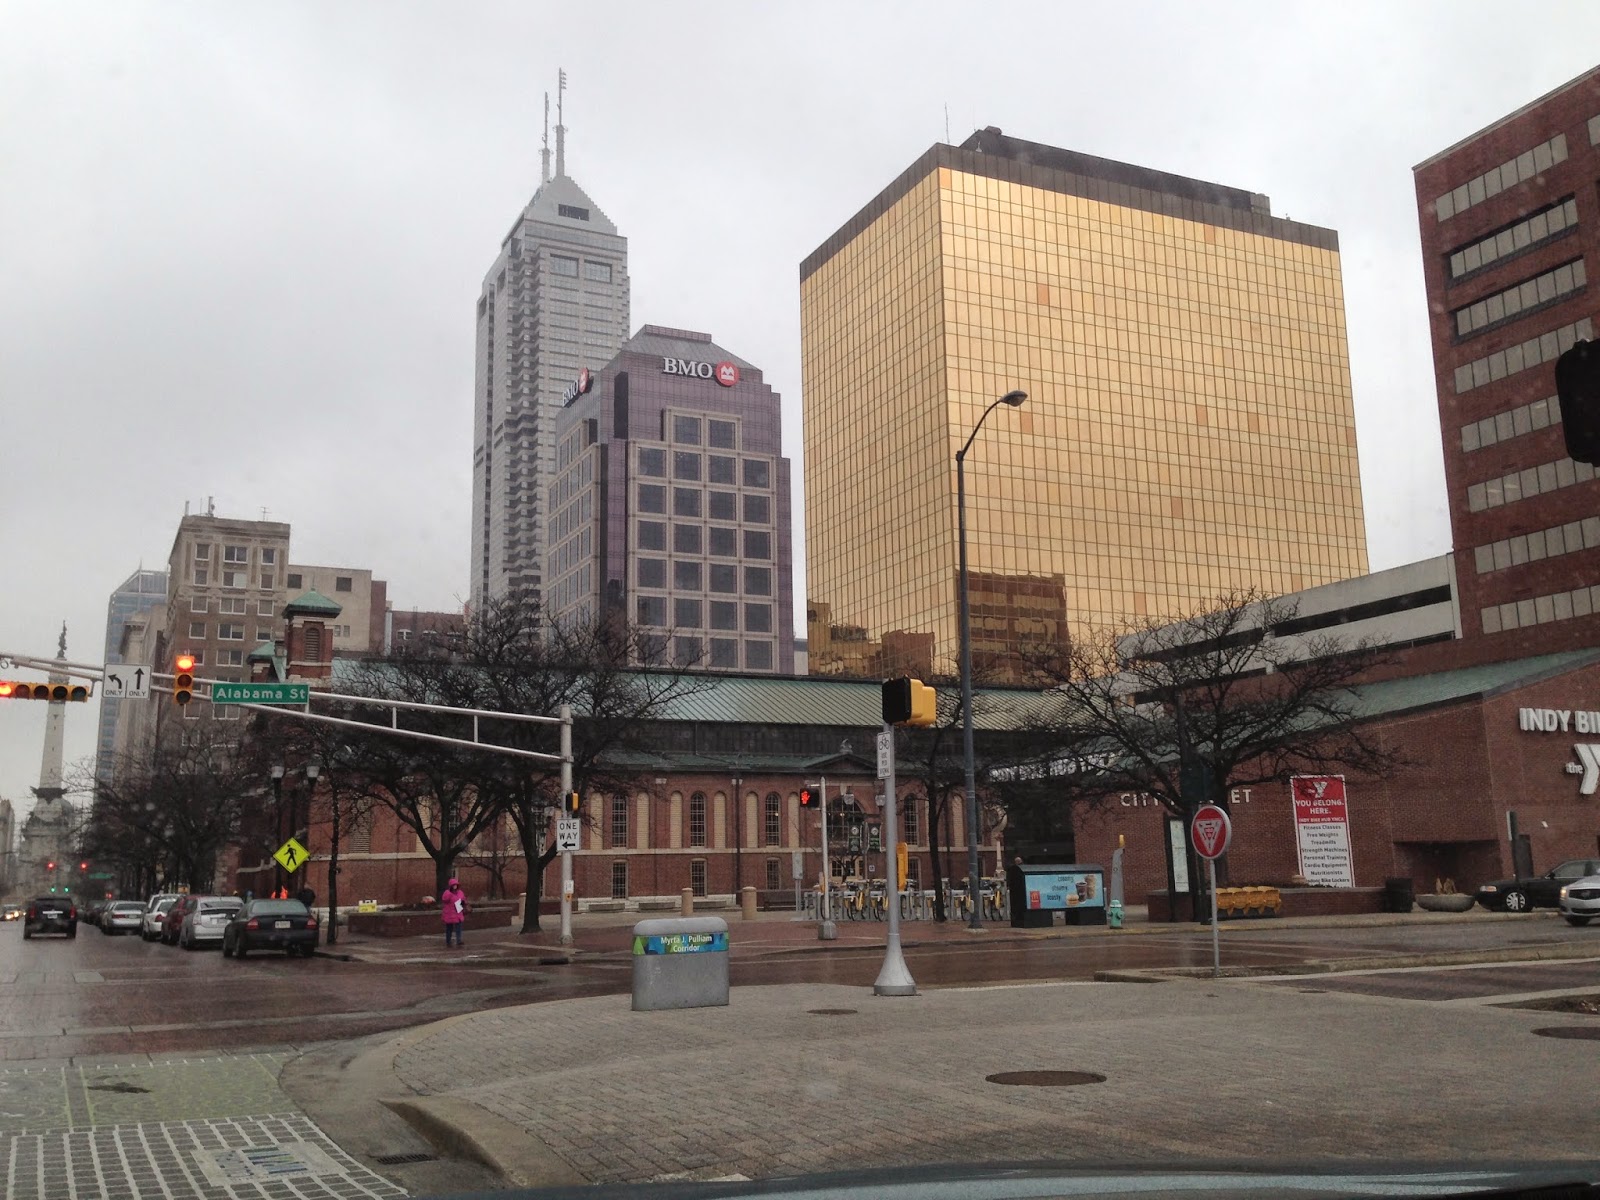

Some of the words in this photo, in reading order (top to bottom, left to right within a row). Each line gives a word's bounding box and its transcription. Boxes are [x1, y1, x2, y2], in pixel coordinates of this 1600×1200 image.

[663, 357, 713, 378] BMO
[216, 688, 283, 700] Alabama
[290, 688, 306, 700] St
[1519, 707, 1571, 732] INDY
[1575, 710, 1600, 734] BI
[1565, 762, 1583, 774] the
[559, 822, 577, 830] ONE
[559, 832, 578, 840] WAY
[660, 937, 680, 945] Myrta
[688, 935, 713, 943] Pulliam
[673, 945, 700, 953] Corridor
